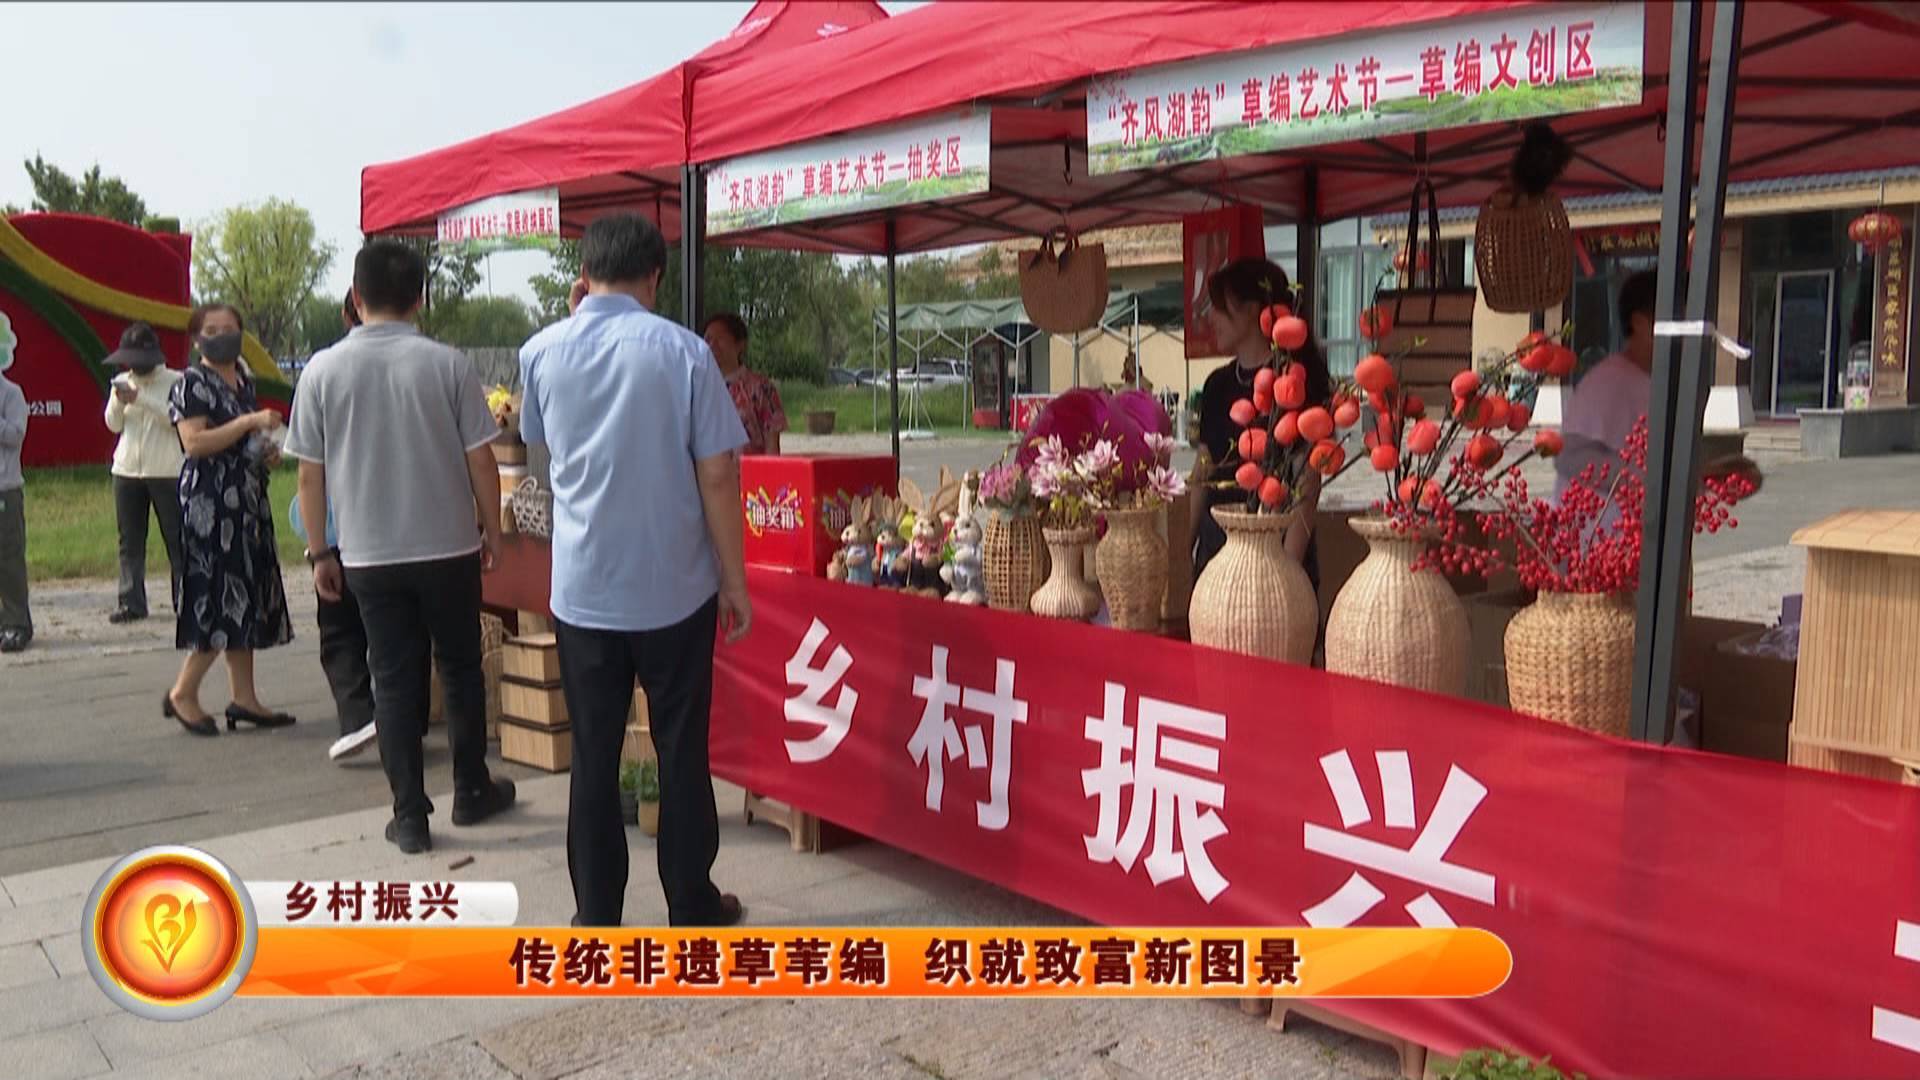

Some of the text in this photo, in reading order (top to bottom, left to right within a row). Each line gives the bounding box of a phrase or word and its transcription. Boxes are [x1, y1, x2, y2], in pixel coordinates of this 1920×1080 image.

[27, 400, 62, 417] 公园
[751, 503, 796, 530] 抽奖箱
[783, 616, 1497, 928] 乡村振兴
